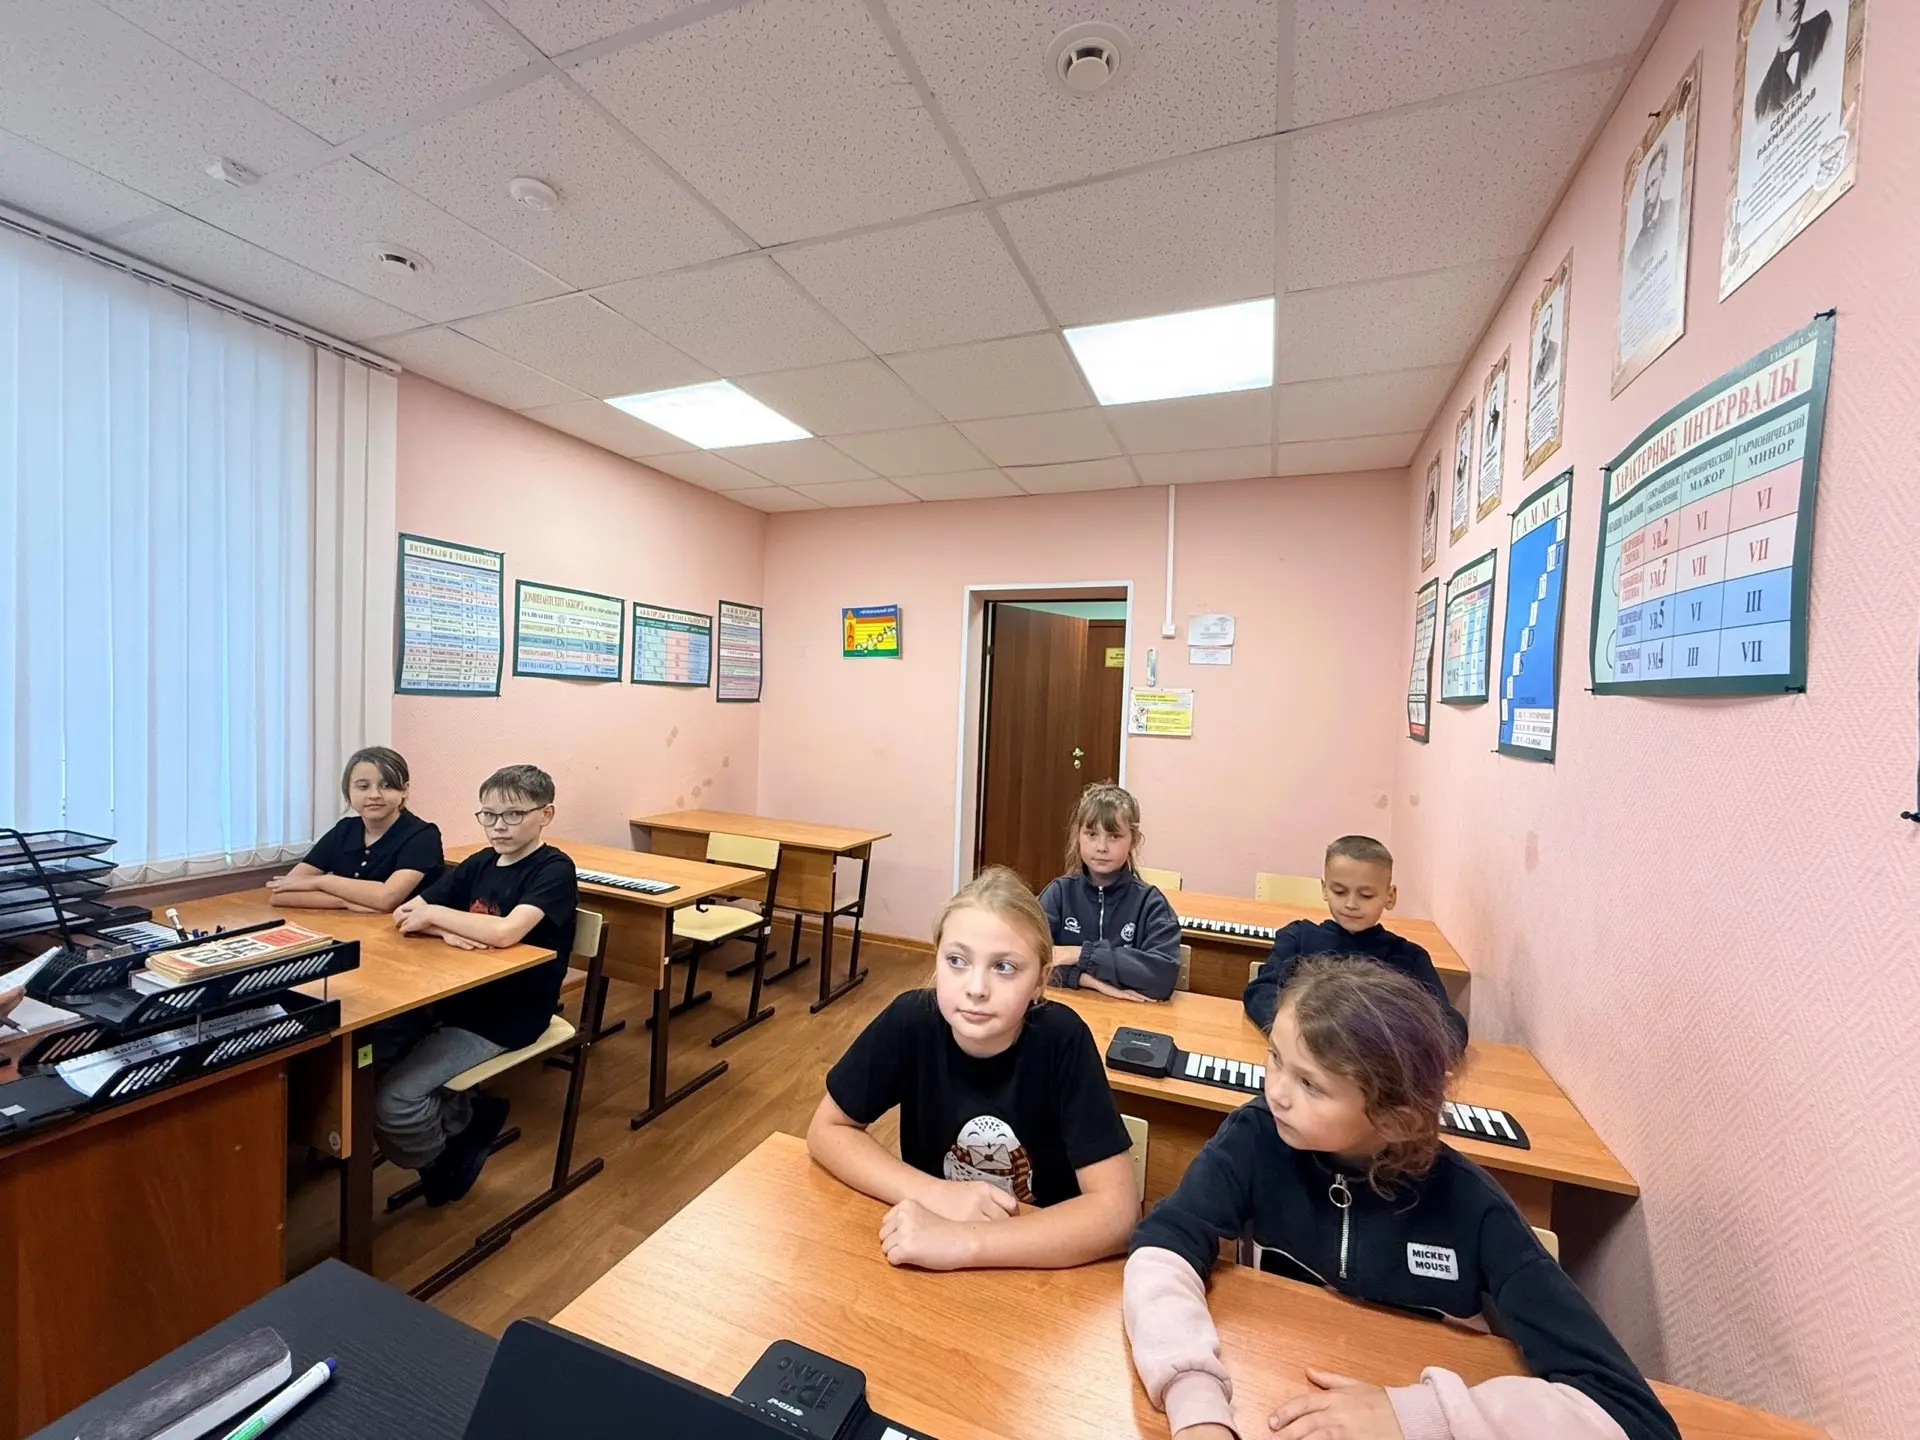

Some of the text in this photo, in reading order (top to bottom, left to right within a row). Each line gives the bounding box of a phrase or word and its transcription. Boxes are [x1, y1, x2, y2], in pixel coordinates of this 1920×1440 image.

[1614, 357, 1801, 497] ХАРАКТЕРНЫЕ ИНТЕРВАЛЫ
[1738, 413, 1805, 456] ГАРМОНИЧЕСКИЙ
[1748, 438, 1795, 469] МИНОР
[1689, 468, 1726, 493] МАЖОР
[1696, 510, 1708, 532] VI
[1757, 487, 1773, 512] VI
[1692, 555, 1707, 577] VII
[1749, 537, 1770, 563] VII
[1691, 601, 1702, 622] VI
[1745, 589, 1762, 613] III
[1687, 646, 1699, 667] III
[1741, 640, 1762, 663] VII
[112, 1040, 153, 1056] АВГУСТ
[120, 1058, 132, 1066] 3
[150, 1048, 160, 1057] 4
[178, 1040, 189, 1048] 5
[1412, 1249, 1450, 1263] MICKEY
[1415, 1261, 1451, 1273] MOUSE
